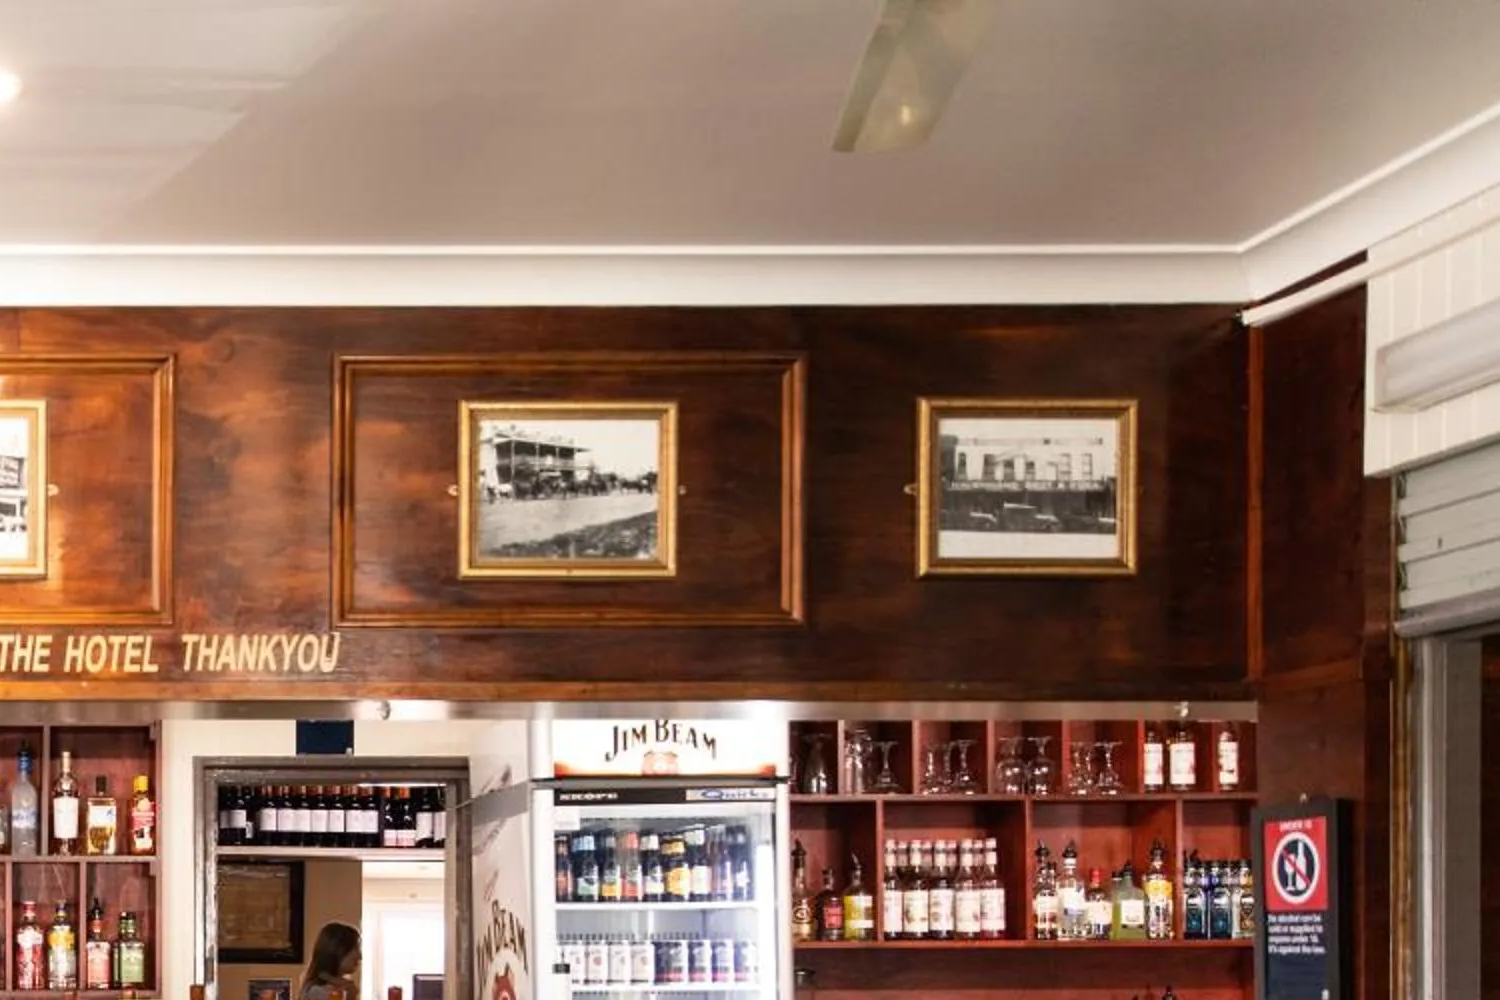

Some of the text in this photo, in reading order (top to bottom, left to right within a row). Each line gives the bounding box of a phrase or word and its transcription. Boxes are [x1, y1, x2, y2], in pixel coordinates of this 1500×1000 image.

[63, 634, 159, 673] HOTEL
[181, 631, 341, 673] THANKYOU
[605, 719, 717, 762] JIM BEAM
[492, 899, 528, 976] BEAM
